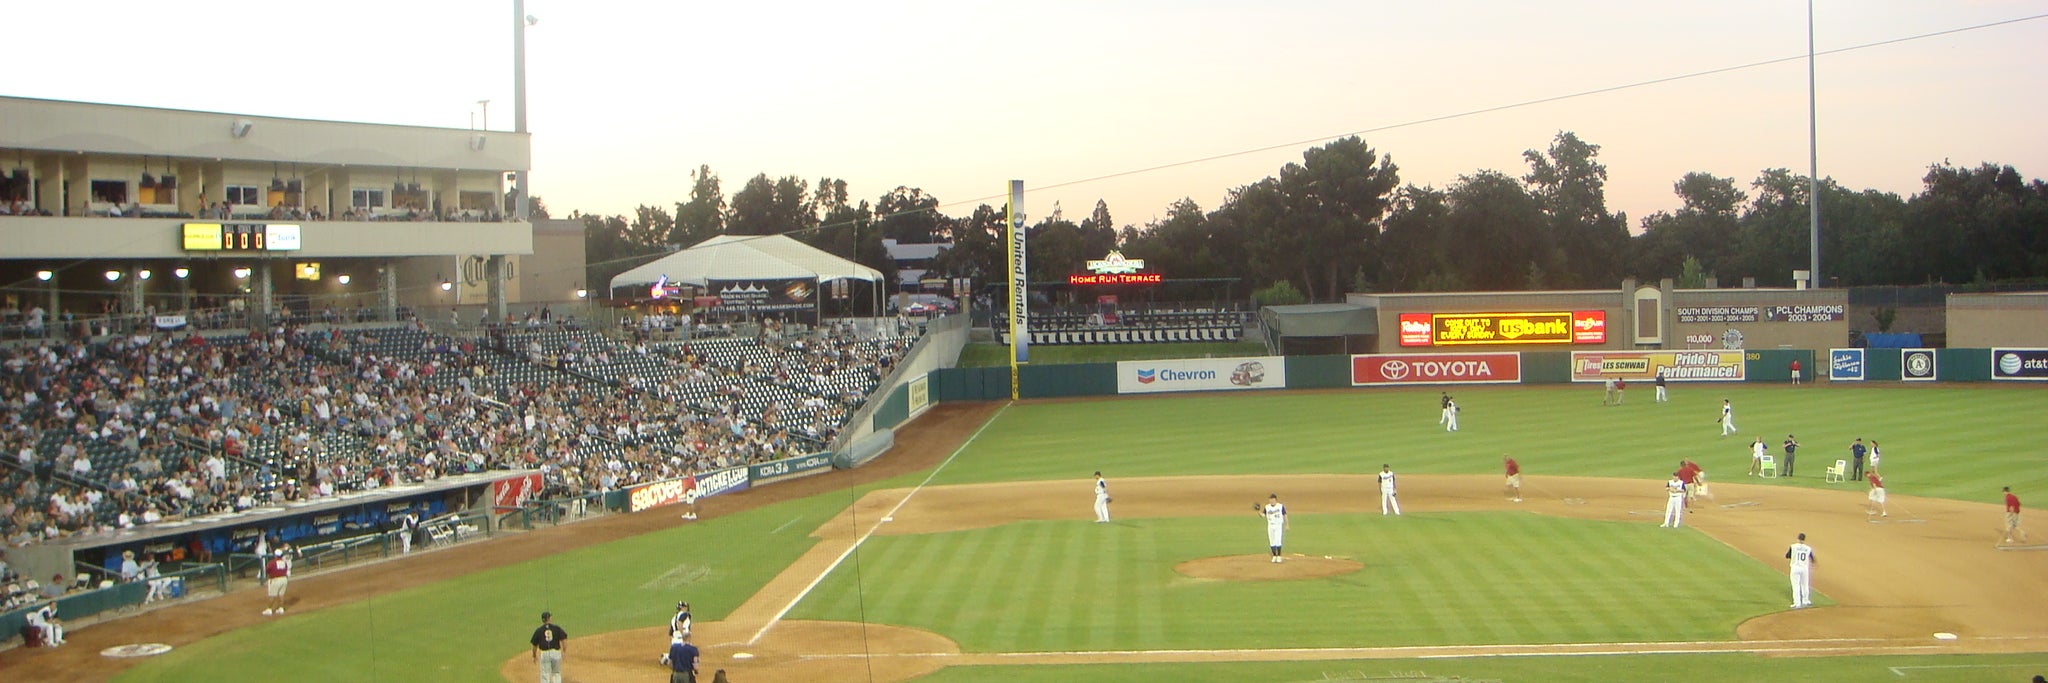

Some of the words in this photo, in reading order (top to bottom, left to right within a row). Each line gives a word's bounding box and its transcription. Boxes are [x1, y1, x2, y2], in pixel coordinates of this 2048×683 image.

[1014, 232, 1024, 275] United
[1071, 275, 1096, 284] HOME
[1099, 275, 1118, 283] RUN
[1120, 274, 1161, 283] TERRACE
[1015, 279, 1026, 325] Rentals
[1731, 307, 1758, 315] CHAMPS
[1776, 306, 1793, 314] PCL
[1794, 305, 1843, 314] CHAMPIONS
[1788, 314, 1807, 322] 2003
[1686, 335, 1713, 343] $10,000
[1583, 359, 1601, 371] Tires
[1602, 360, 1615, 370] LES
[1615, 358, 1646, 369] SCHWAB
[1674, 353, 1704, 366] Pride
[1706, 353, 1720, 365] In
[2024, 358, 2047, 369] at&t
[1160, 368, 1216, 381] Chevron
[1412, 360, 1492, 377] TOYOTA
[1656, 364, 1739, 379] Performance!
[775, 462, 782, 474] 3
[1797, 552, 1806, 562] 10
[544, 629, 553, 642] 9
